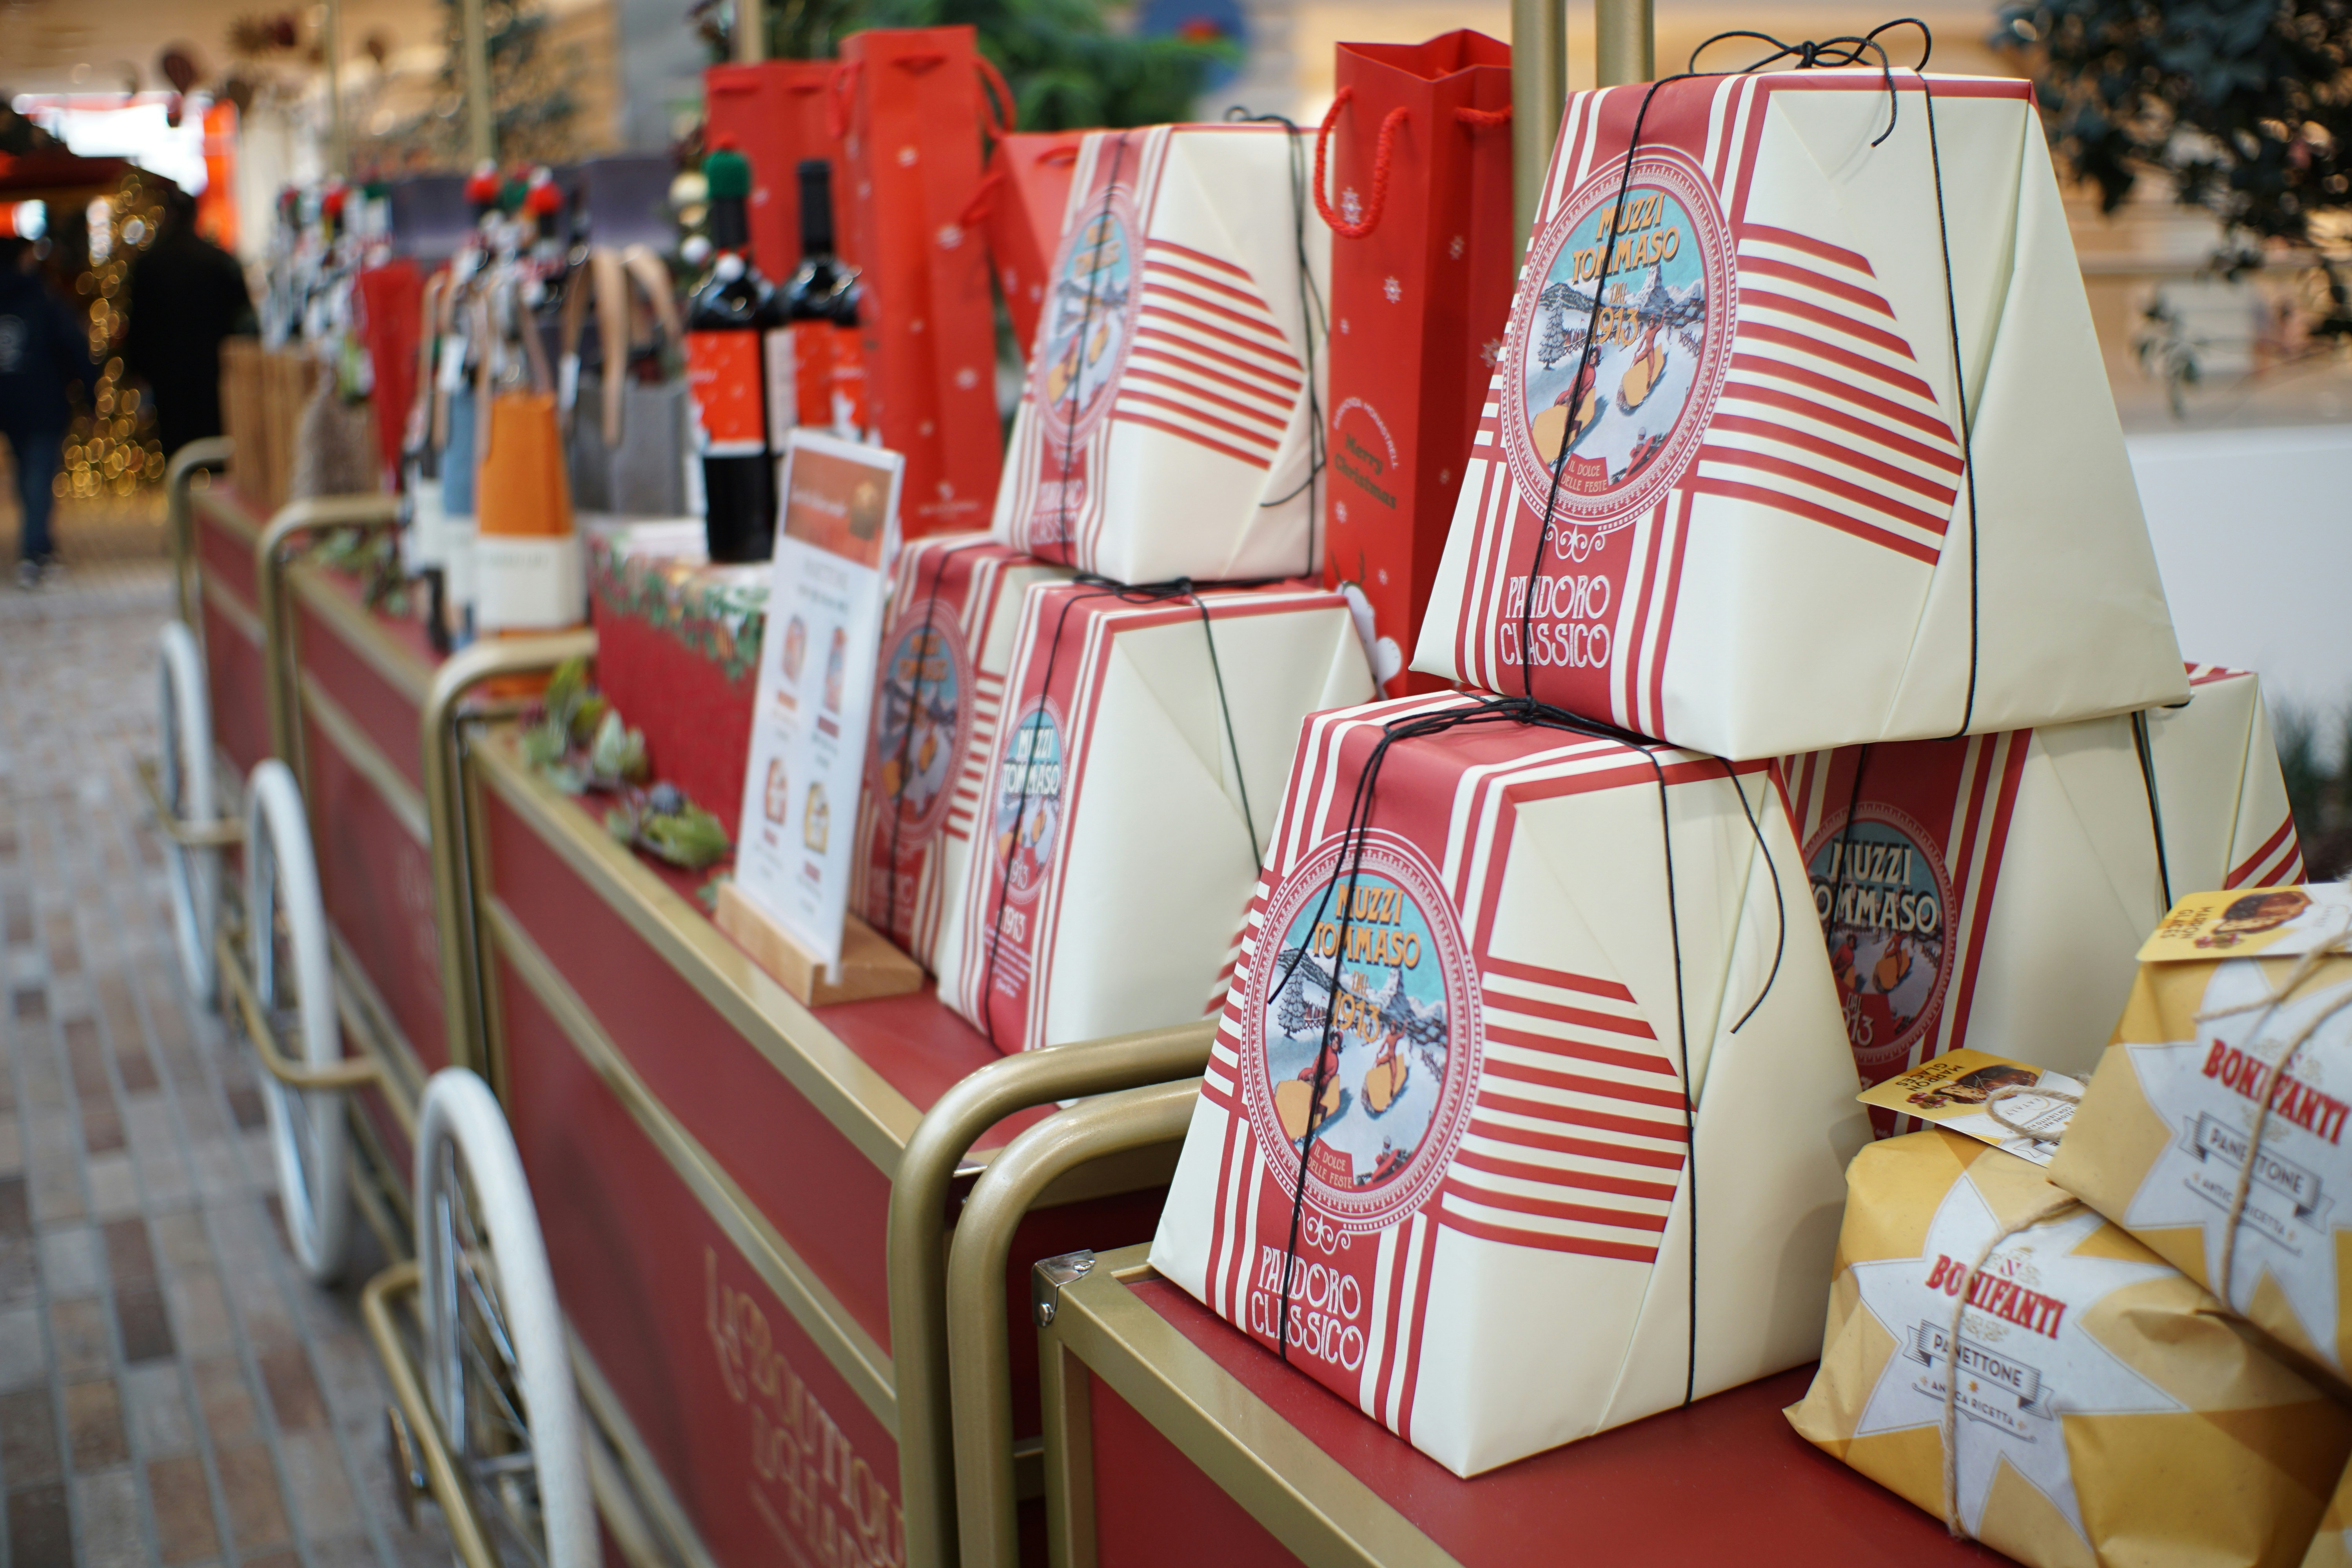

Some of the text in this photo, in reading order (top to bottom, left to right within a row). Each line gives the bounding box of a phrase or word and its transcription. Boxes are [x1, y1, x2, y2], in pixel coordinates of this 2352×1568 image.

[1596, 192, 1665, 240] MUZZI
[1572, 226, 1680, 284] TOMMASO
[1610, 282, 1627, 304] DAL
[1591, 307, 1640, 347] 1913
[1346, 433, 1383, 475] Merry
[1568, 460, 1601, 477] IL DOLCE
[1561, 473, 1607, 492] DELLE FESTE
[1505, 575, 1610, 619] PANDORO
[1500, 623, 1611, 668] CLASSICO
[1829, 841, 1912, 885] MUZZI
[1335, 884, 1403, 925] MUZZI
[1811, 884, 1937, 933] OMMASO
[1313, 920, 1421, 969] TOMMASO
[1351, 970, 1368, 996] DAL
[1333, 989, 1381, 1043] 1913
[1906, 1065, 1965, 1091] MARRON
[1307, 1154, 1352, 1189] DELLE FESTE
[1314, 1144, 1346, 1171] IL DOLCE
[1258, 1245, 1361, 1319] PANDORO
[1925, 1254, 2067, 1339] BONIFANTI
[1931, 1381, 2014, 1426] ANCA RICETTA
